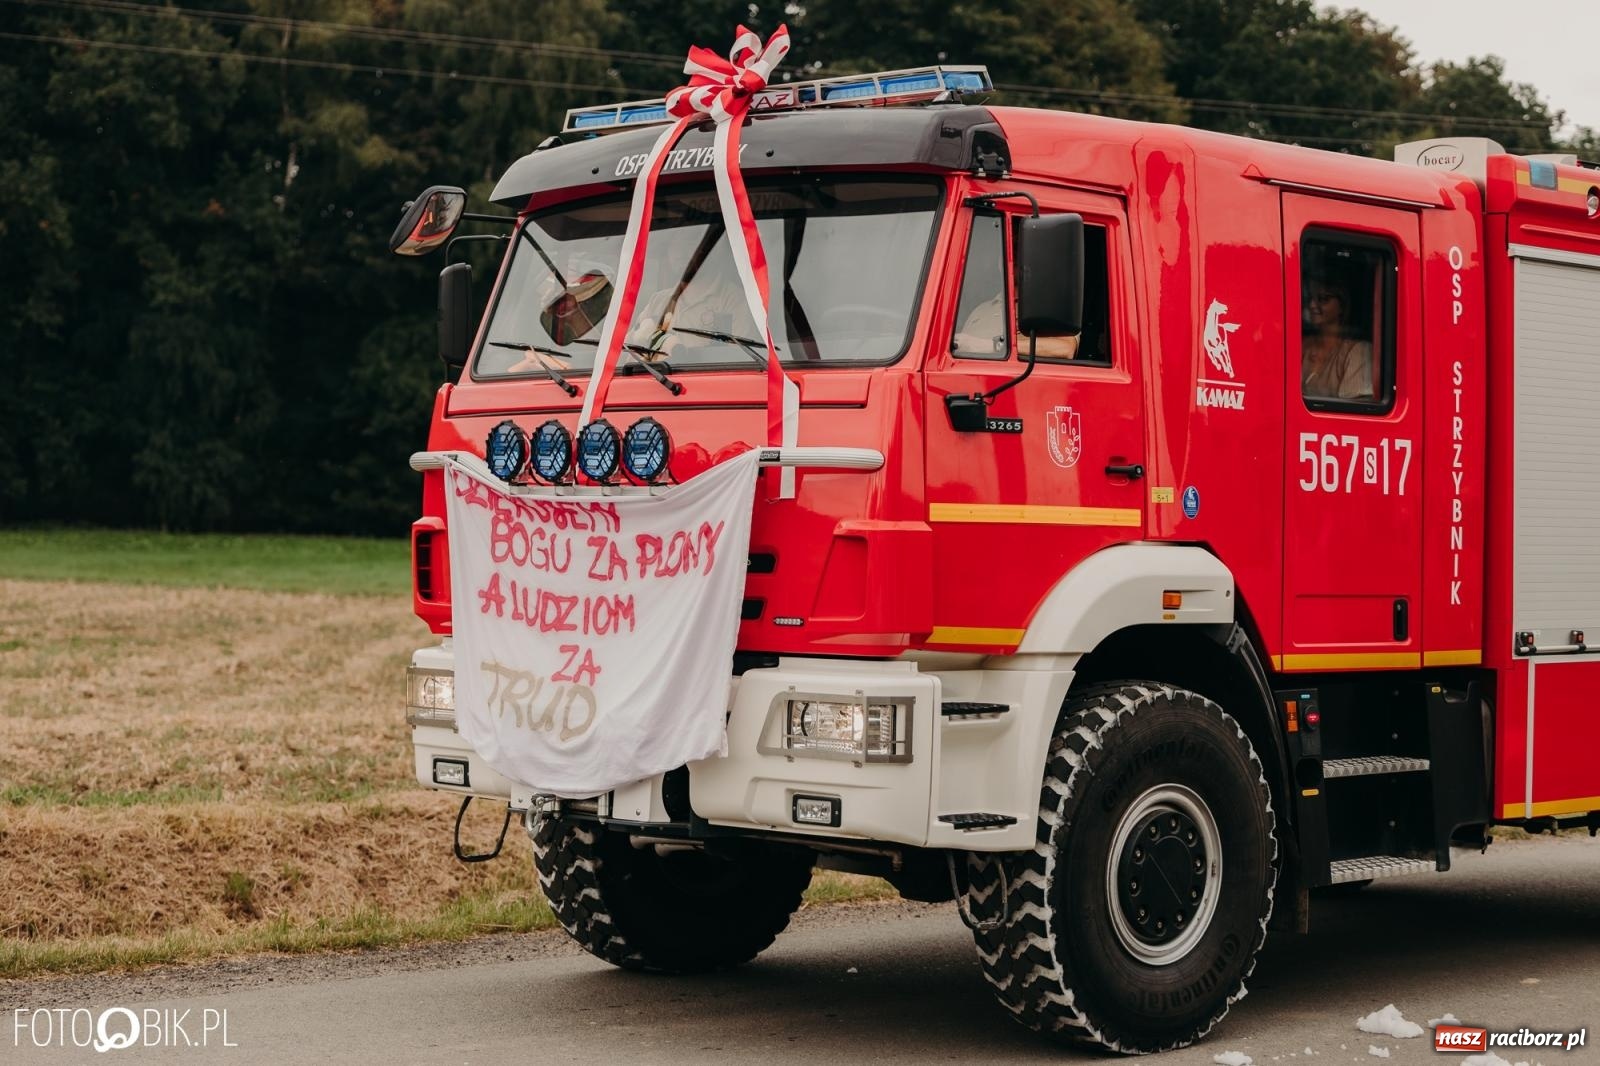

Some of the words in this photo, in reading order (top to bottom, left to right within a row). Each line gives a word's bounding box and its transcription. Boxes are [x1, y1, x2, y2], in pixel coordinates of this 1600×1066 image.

[615, 154, 648, 176] OSP
[1423, 154, 1458, 166] bocar
[1449, 246, 1463, 326] OSP
[1196, 386, 1246, 410] KAMAZ
[986, 421, 1021, 431] 3265
[1450, 361, 1464, 605] STRZYBNIK
[491, 516, 571, 573] BOGU
[587, 536, 628, 581] ZA
[635, 520, 725, 578] PLONY
[478, 572, 506, 618] A
[510, 580, 635, 636] LUDZIOM
[551, 644, 602, 687] ZA
[480, 661, 597, 742] TRUD
